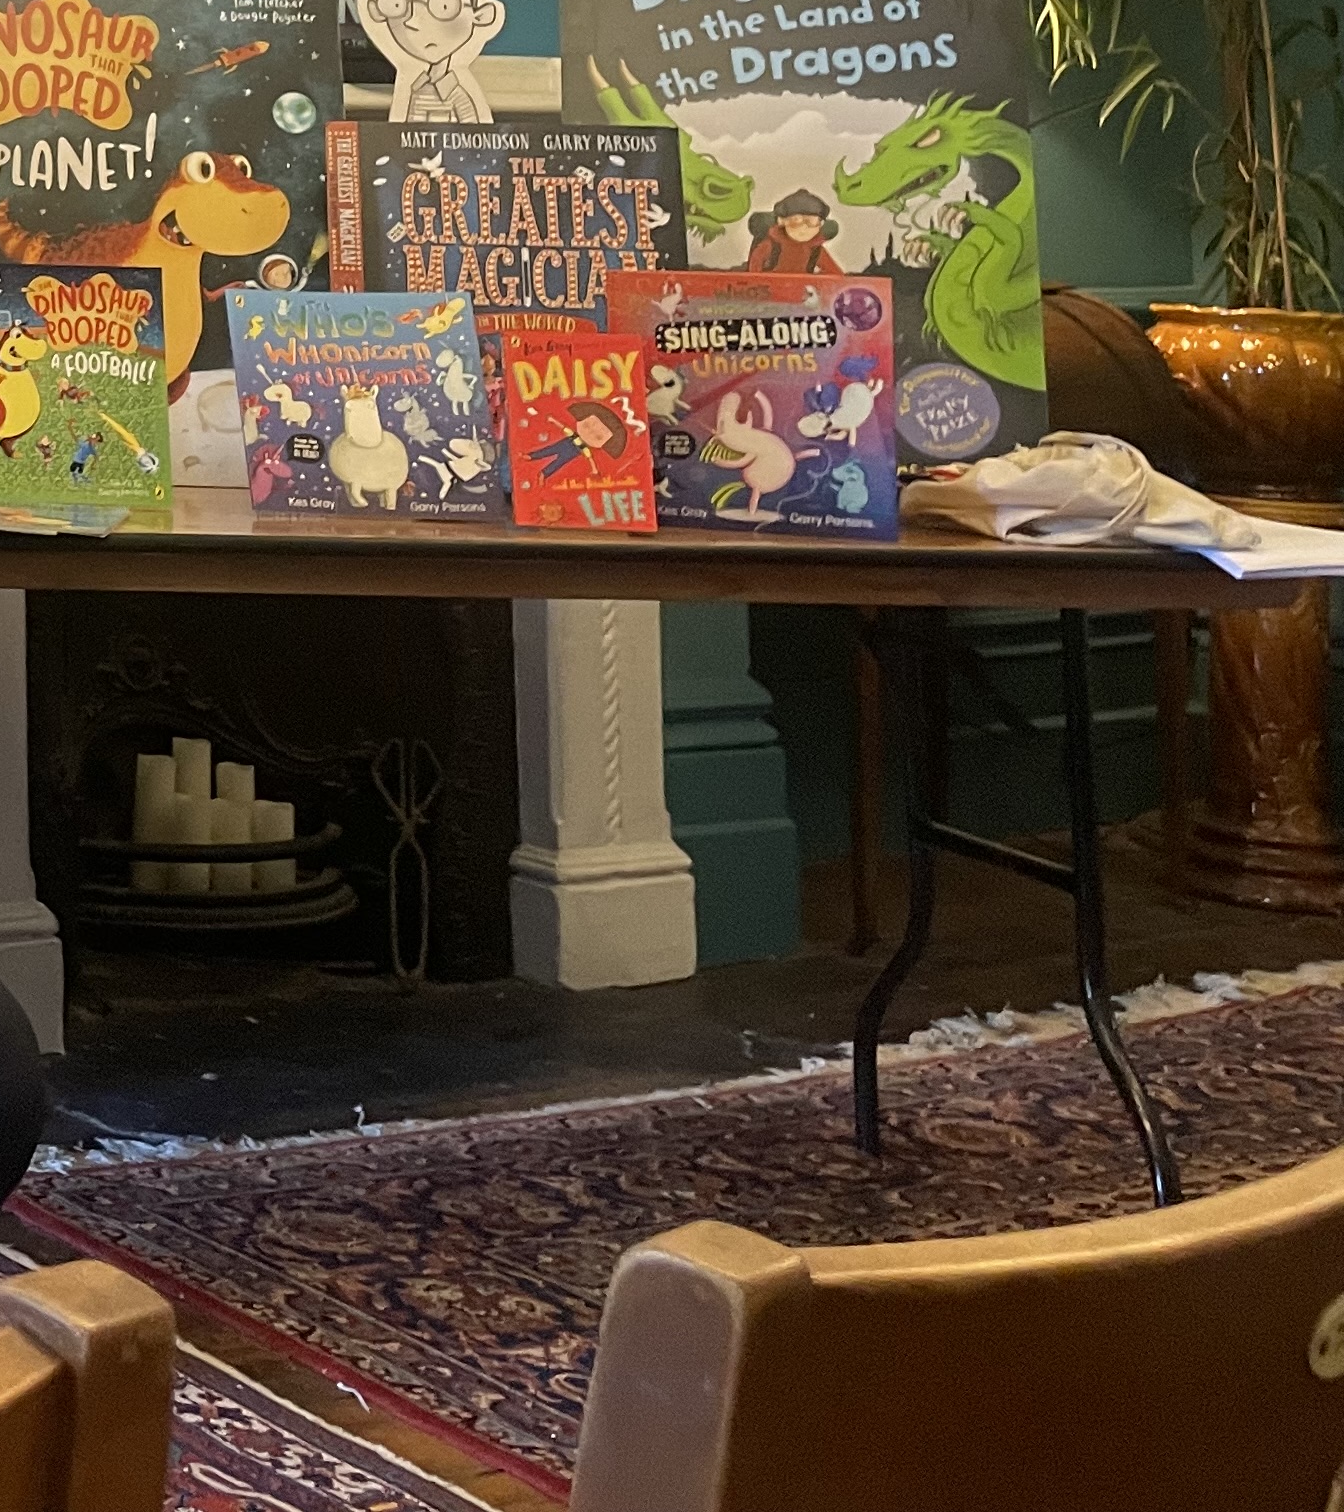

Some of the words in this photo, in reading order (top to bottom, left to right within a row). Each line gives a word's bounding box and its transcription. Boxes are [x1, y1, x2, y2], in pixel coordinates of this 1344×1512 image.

[219, 11, 228, 23] &
[230, 11, 268, 24] Dougie
[272, 12, 317, 26] Poynter
[657, 24, 694, 52] in
[699, 9, 766, 41] the
[89, 53, 125, 77] THAT
[655, 67, 720, 100] the
[730, 32, 958, 86] Dragons
[400, 131, 436, 150] MATT
[442, 132, 530, 151] EDMONDSON
[543, 133, 592, 152] GARRY
[596, 134, 658, 153] PARSONS
[336, 155, 354, 204] GREATEST
[508, 156, 547, 176] THE
[401, 171, 661, 251] GREATEST
[338, 208, 358, 265] MAGICIAN
[33, 280, 151, 317] DINOSAUR
[45, 316, 132, 348] POOPED
[270, 300, 396, 340] WHO'S
[663, 319, 829, 352] SING-ALONG
[51, 352, 60, 369] A
[64, 351, 157, 385] FOOTBALL!
[512, 350, 640, 404] DAISY
[691, 352, 818, 379] Unicorns
[288, 496, 308, 509] Kes
[310, 496, 336, 511] Gray
[409, 502, 440, 514] Garry
[441, 502, 487, 513] Parsons
[577, 489, 647, 527] LIFE
[789, 511, 823, 527] Garry
[824, 515, 875, 529] Parsons
